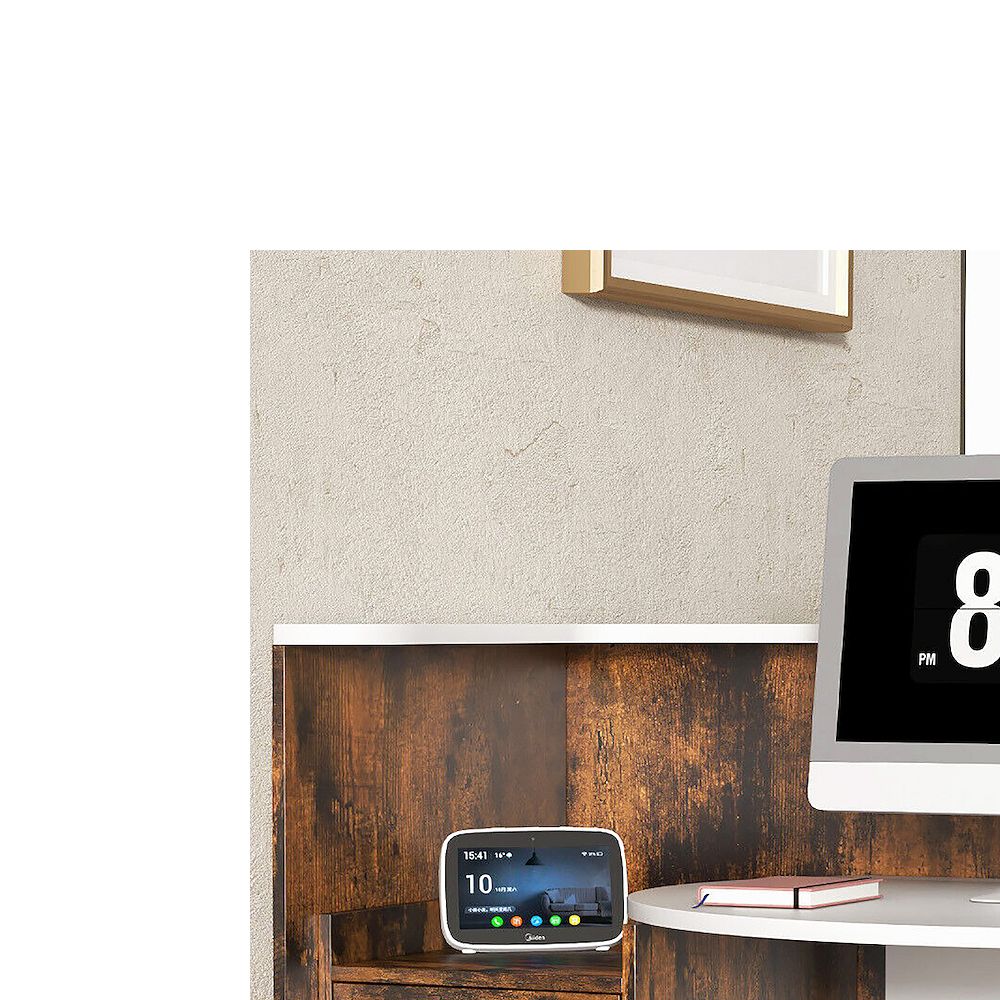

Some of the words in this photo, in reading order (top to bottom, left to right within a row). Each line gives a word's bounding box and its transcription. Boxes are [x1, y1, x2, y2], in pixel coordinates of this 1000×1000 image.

[918, 652, 937, 666] PM
[463, 851, 488, 860] 15:41
[465, 874, 493, 894] 10
